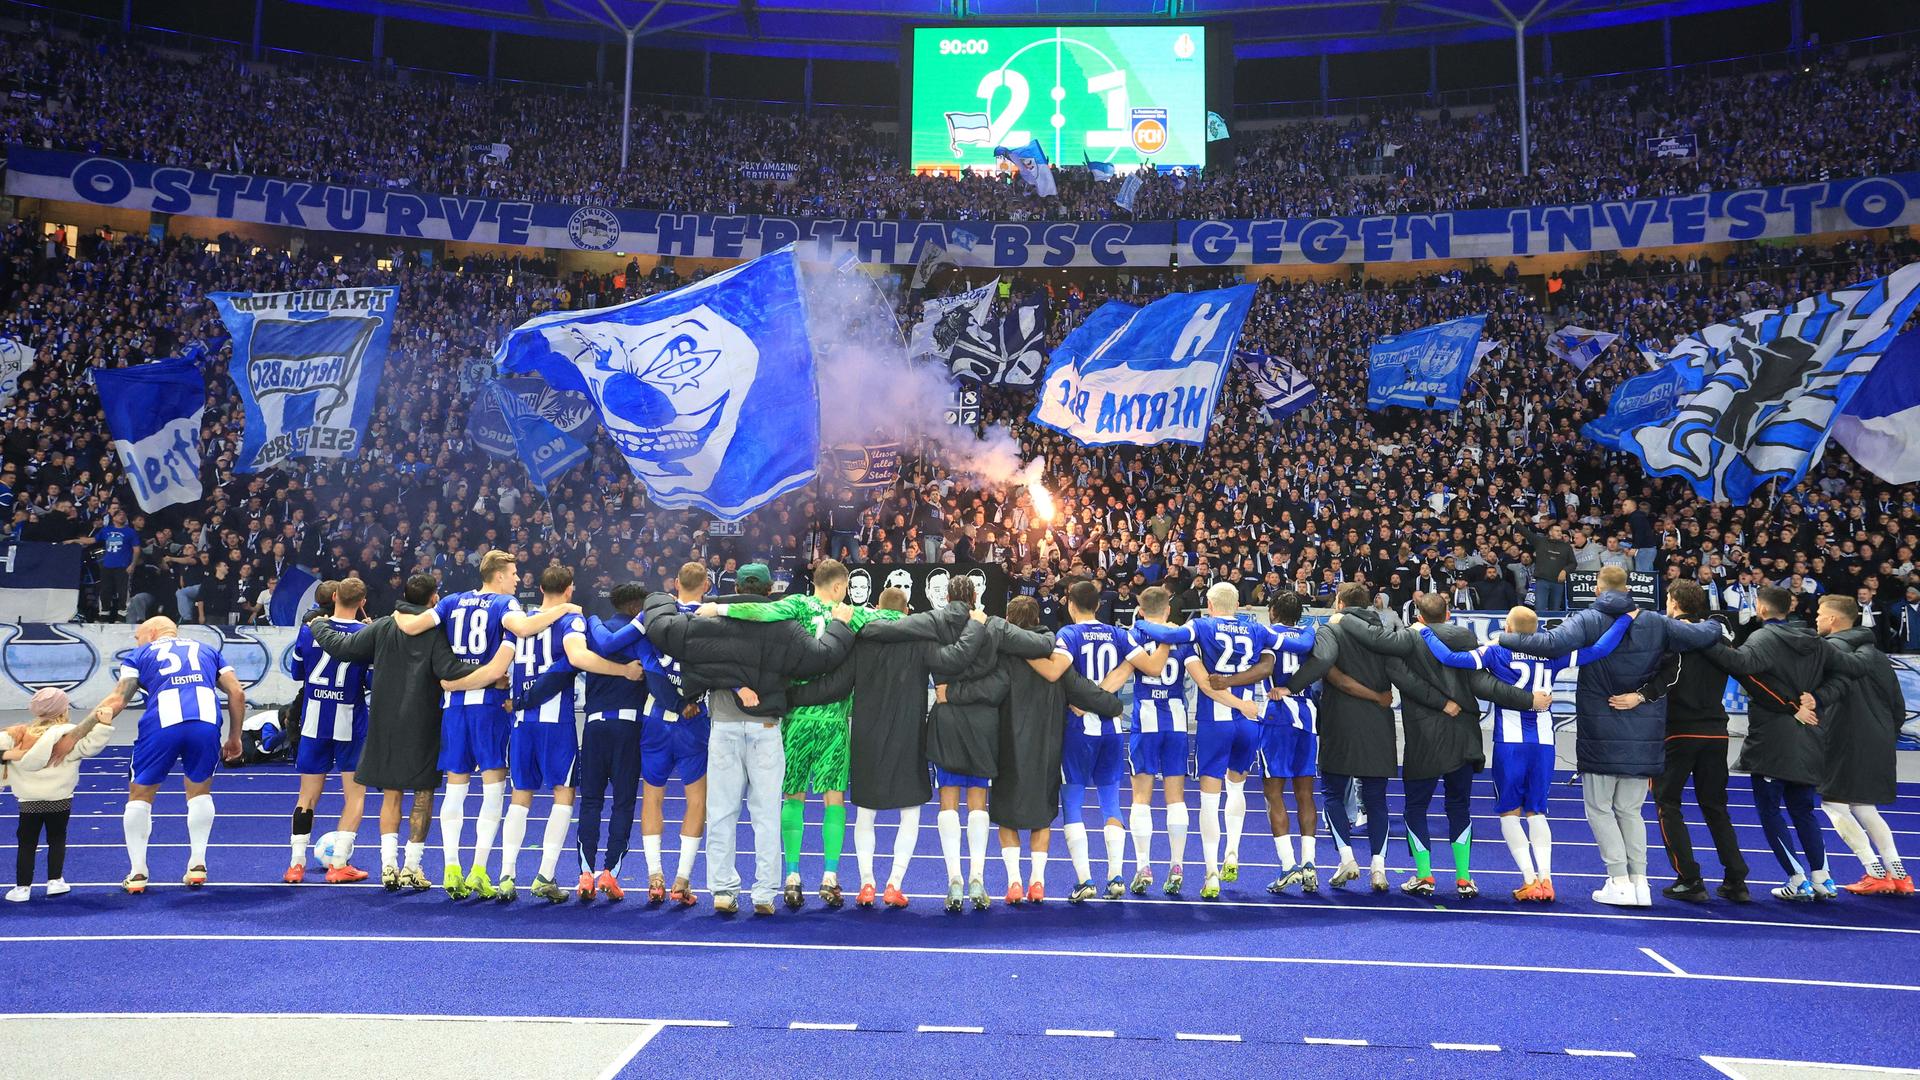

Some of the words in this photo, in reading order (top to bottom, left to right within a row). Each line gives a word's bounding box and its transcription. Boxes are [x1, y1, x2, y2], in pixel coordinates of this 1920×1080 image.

[939, 39, 989, 55] 90:00
[976, 69, 1031, 147] 2
[1086, 70, 1131, 147] 1
[1137, 129, 1162, 143] FCH
[70, 157, 534, 245] OSTKURVE
[1190, 213, 1453, 265] GEGEN
[1507, 176, 1911, 254] INVESTO
[655, 213, 950, 264] HERTHA
[991, 222, 1133, 267] BSC
[963, 411, 977, 424] 2
[450, 607, 489, 655] 18
[149, 640, 202, 677] 37
[514, 627, 554, 677] 41
[1080, 642, 1119, 687] 10
[171, 674, 204, 685] LEISTNER
[313, 689, 345, 701] CUISANCE
[1509, 661, 1553, 695] 24
